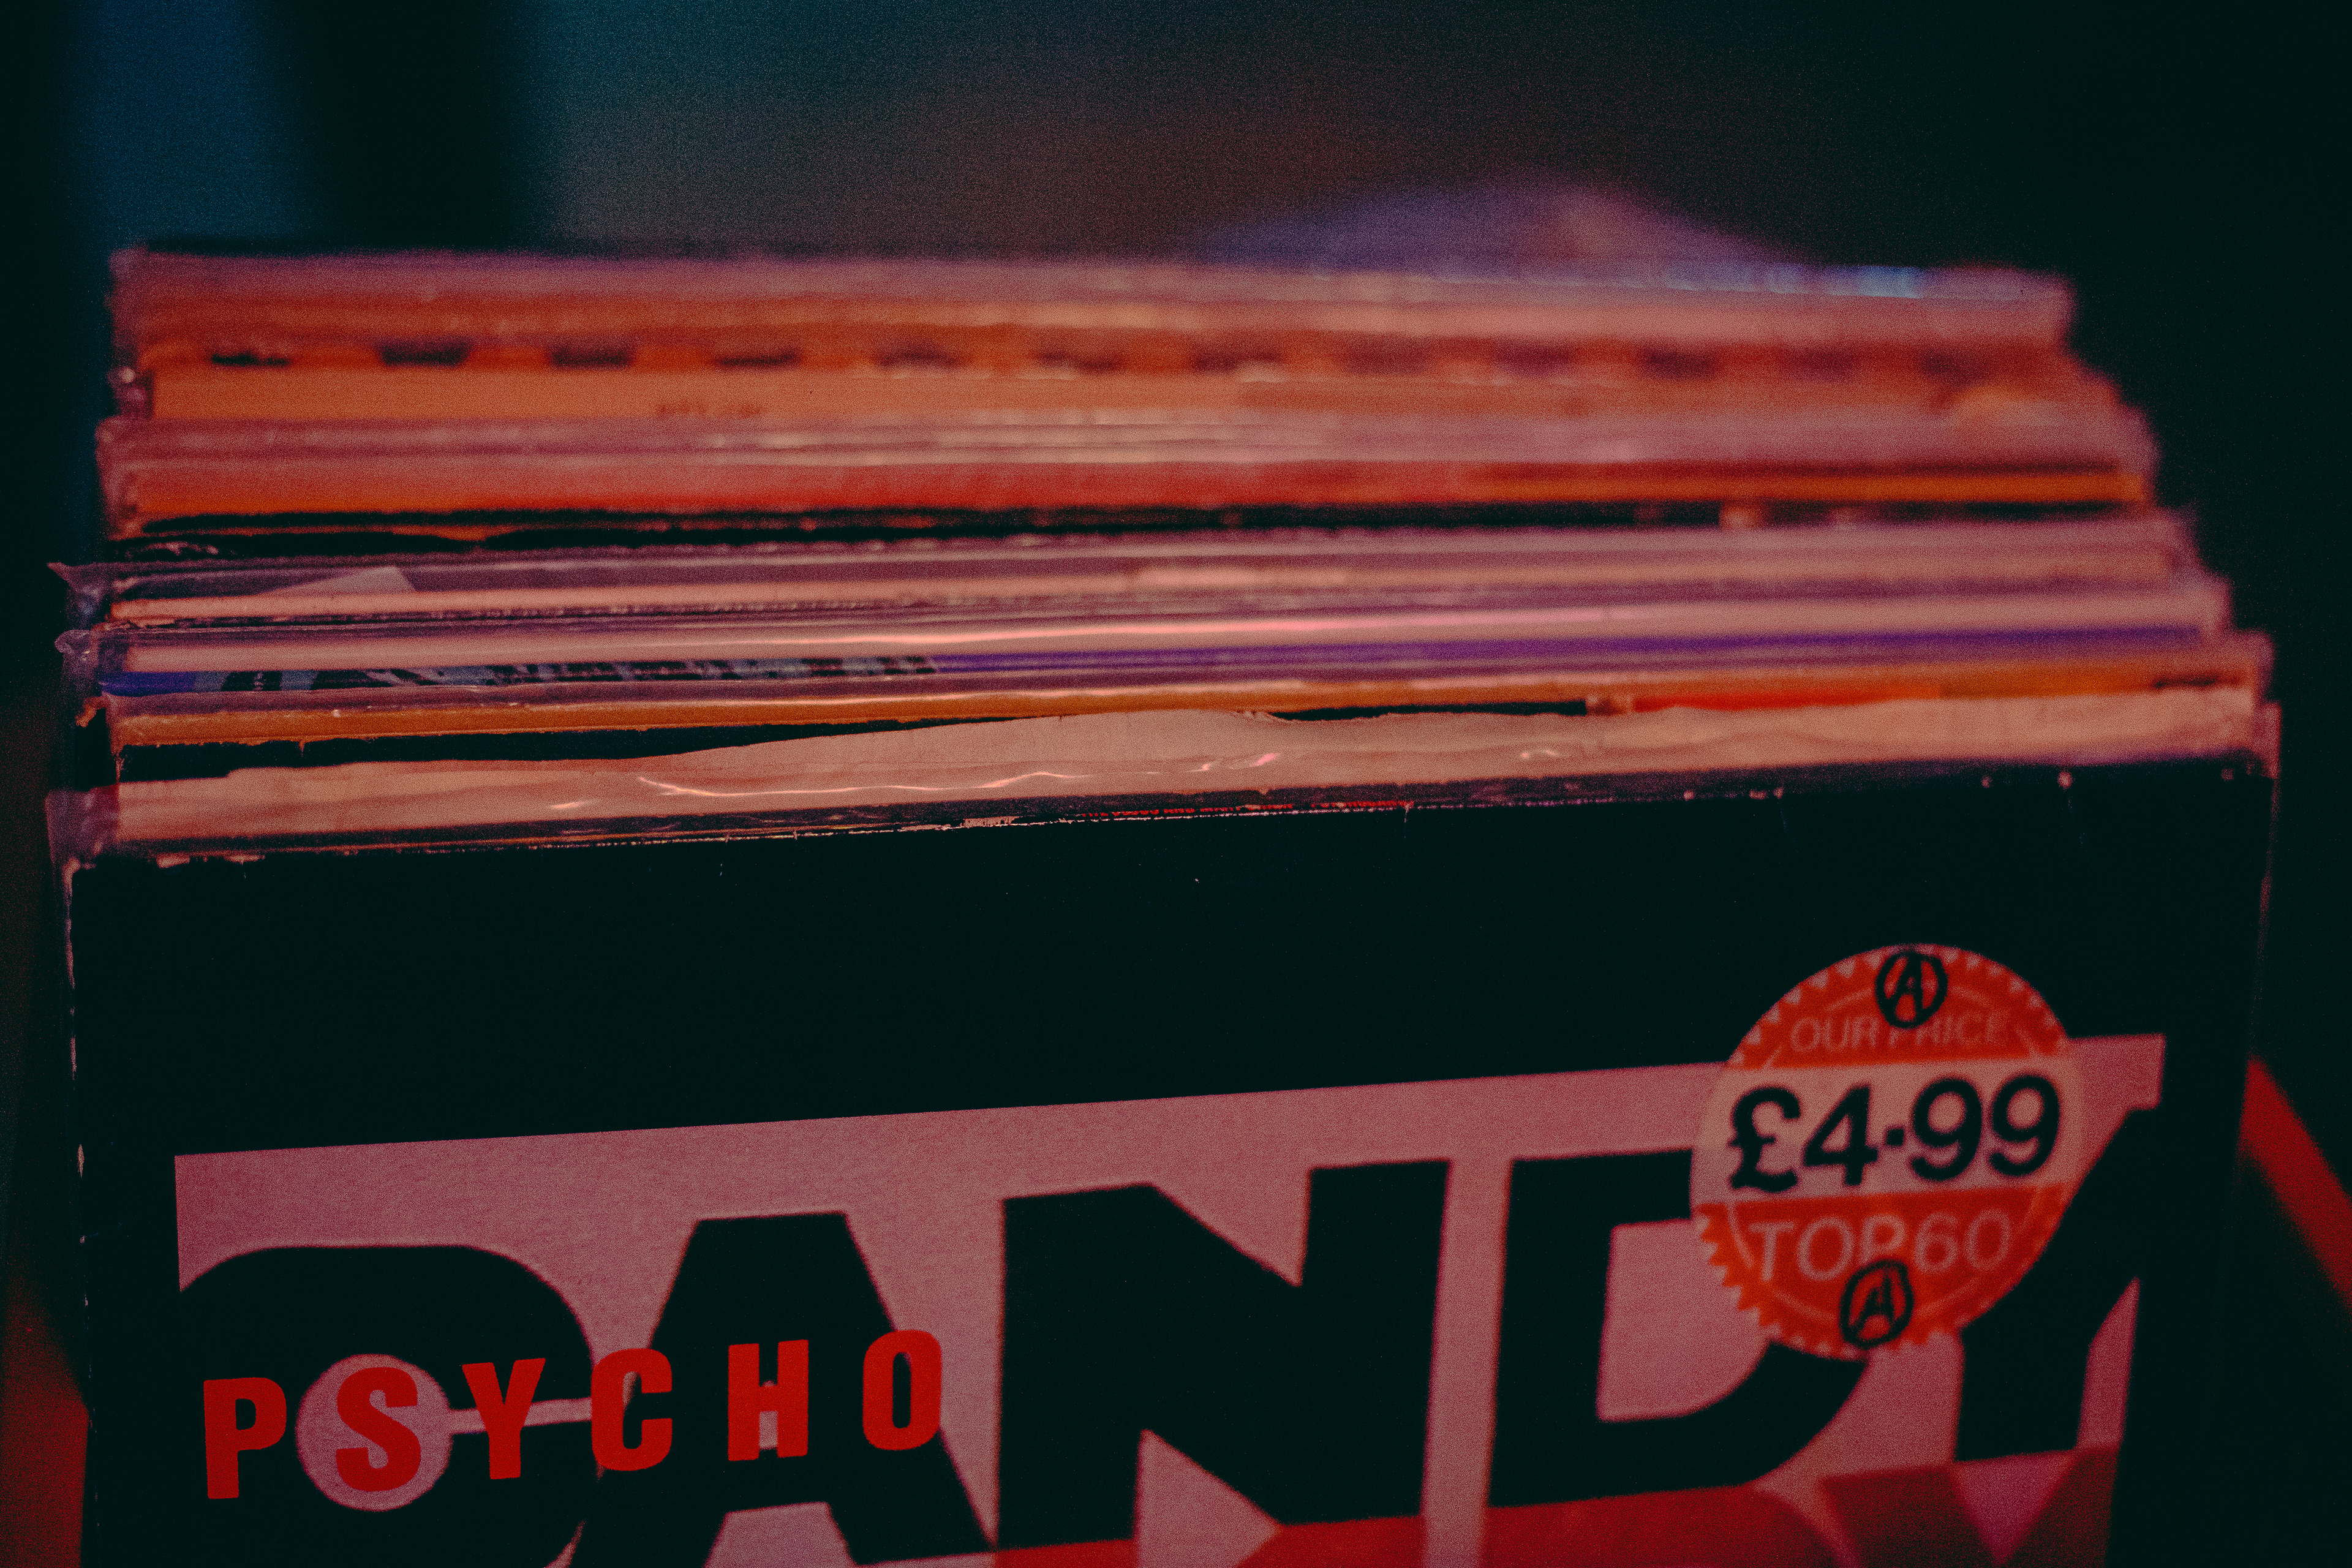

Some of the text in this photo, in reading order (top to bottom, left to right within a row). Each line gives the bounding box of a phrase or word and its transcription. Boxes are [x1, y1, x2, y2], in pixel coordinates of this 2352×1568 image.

[1790, 1014, 1881, 1054] OUR
[1749, 1209, 2011, 1283] TOP 60
[203, 1329, 942, 1499] PSYCHO
